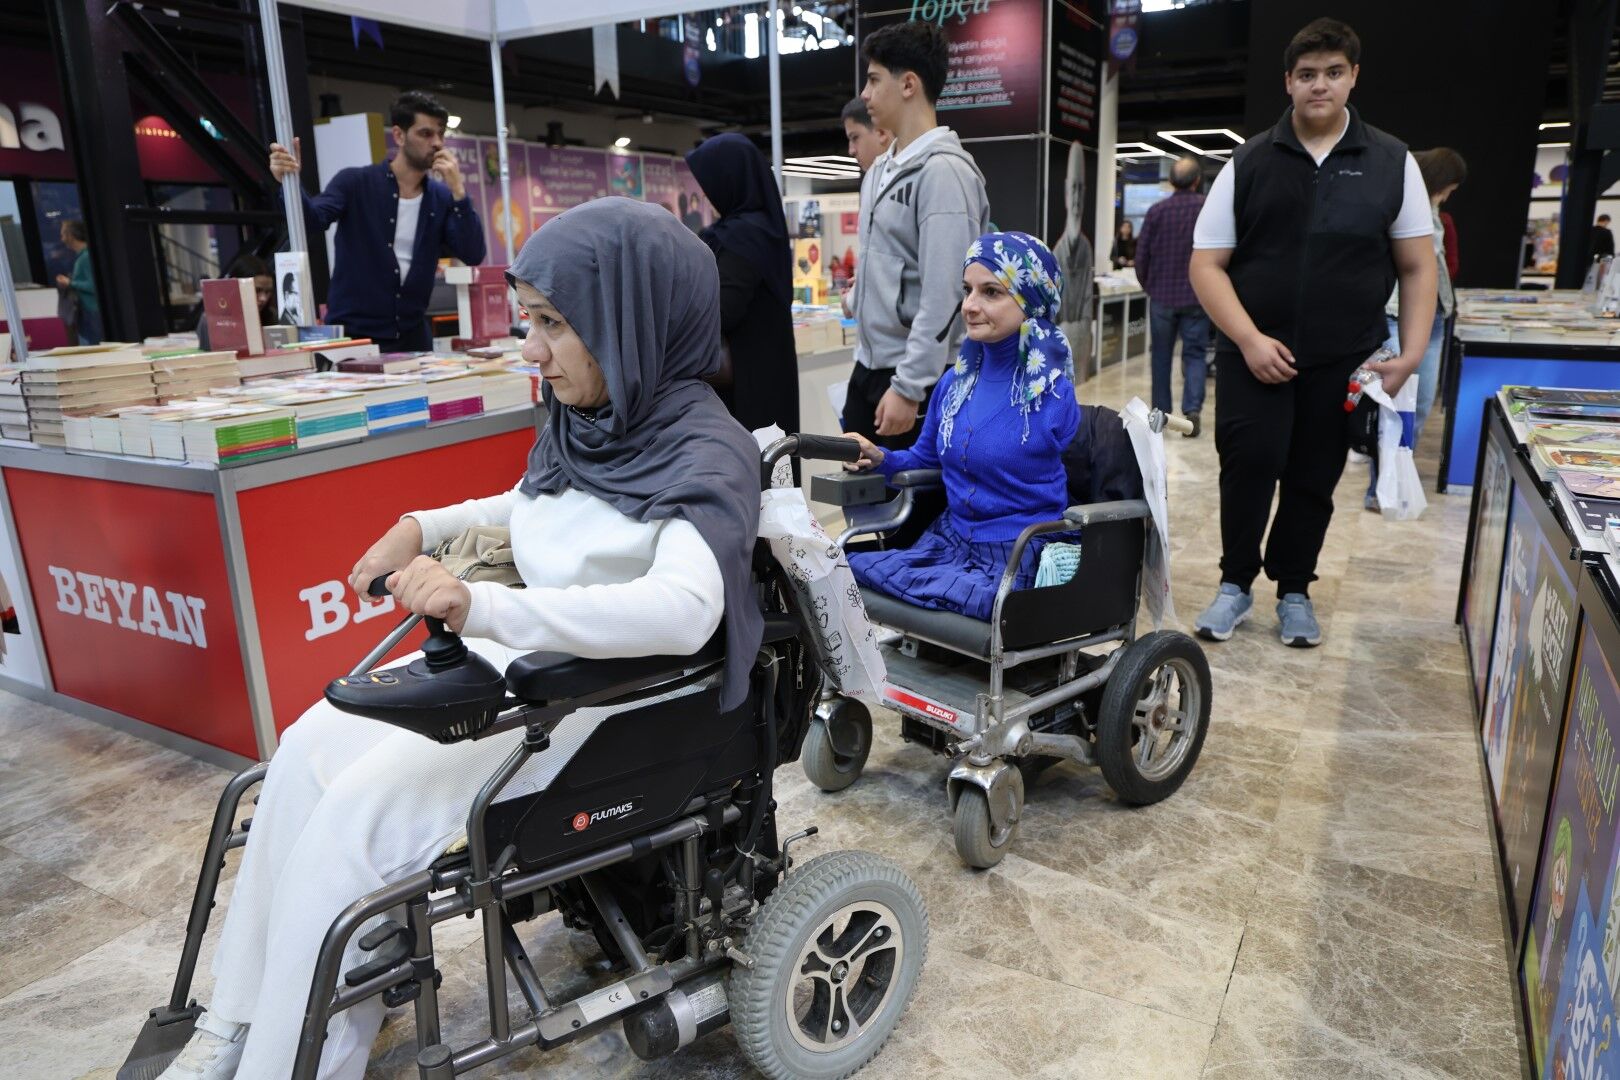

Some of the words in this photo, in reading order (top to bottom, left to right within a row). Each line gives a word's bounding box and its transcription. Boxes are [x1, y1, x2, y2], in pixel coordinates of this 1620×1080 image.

[48, 564, 207, 650] BEYAN
[925, 704, 954, 721] SUZUKI
[589, 802, 633, 825] FULMAKS
